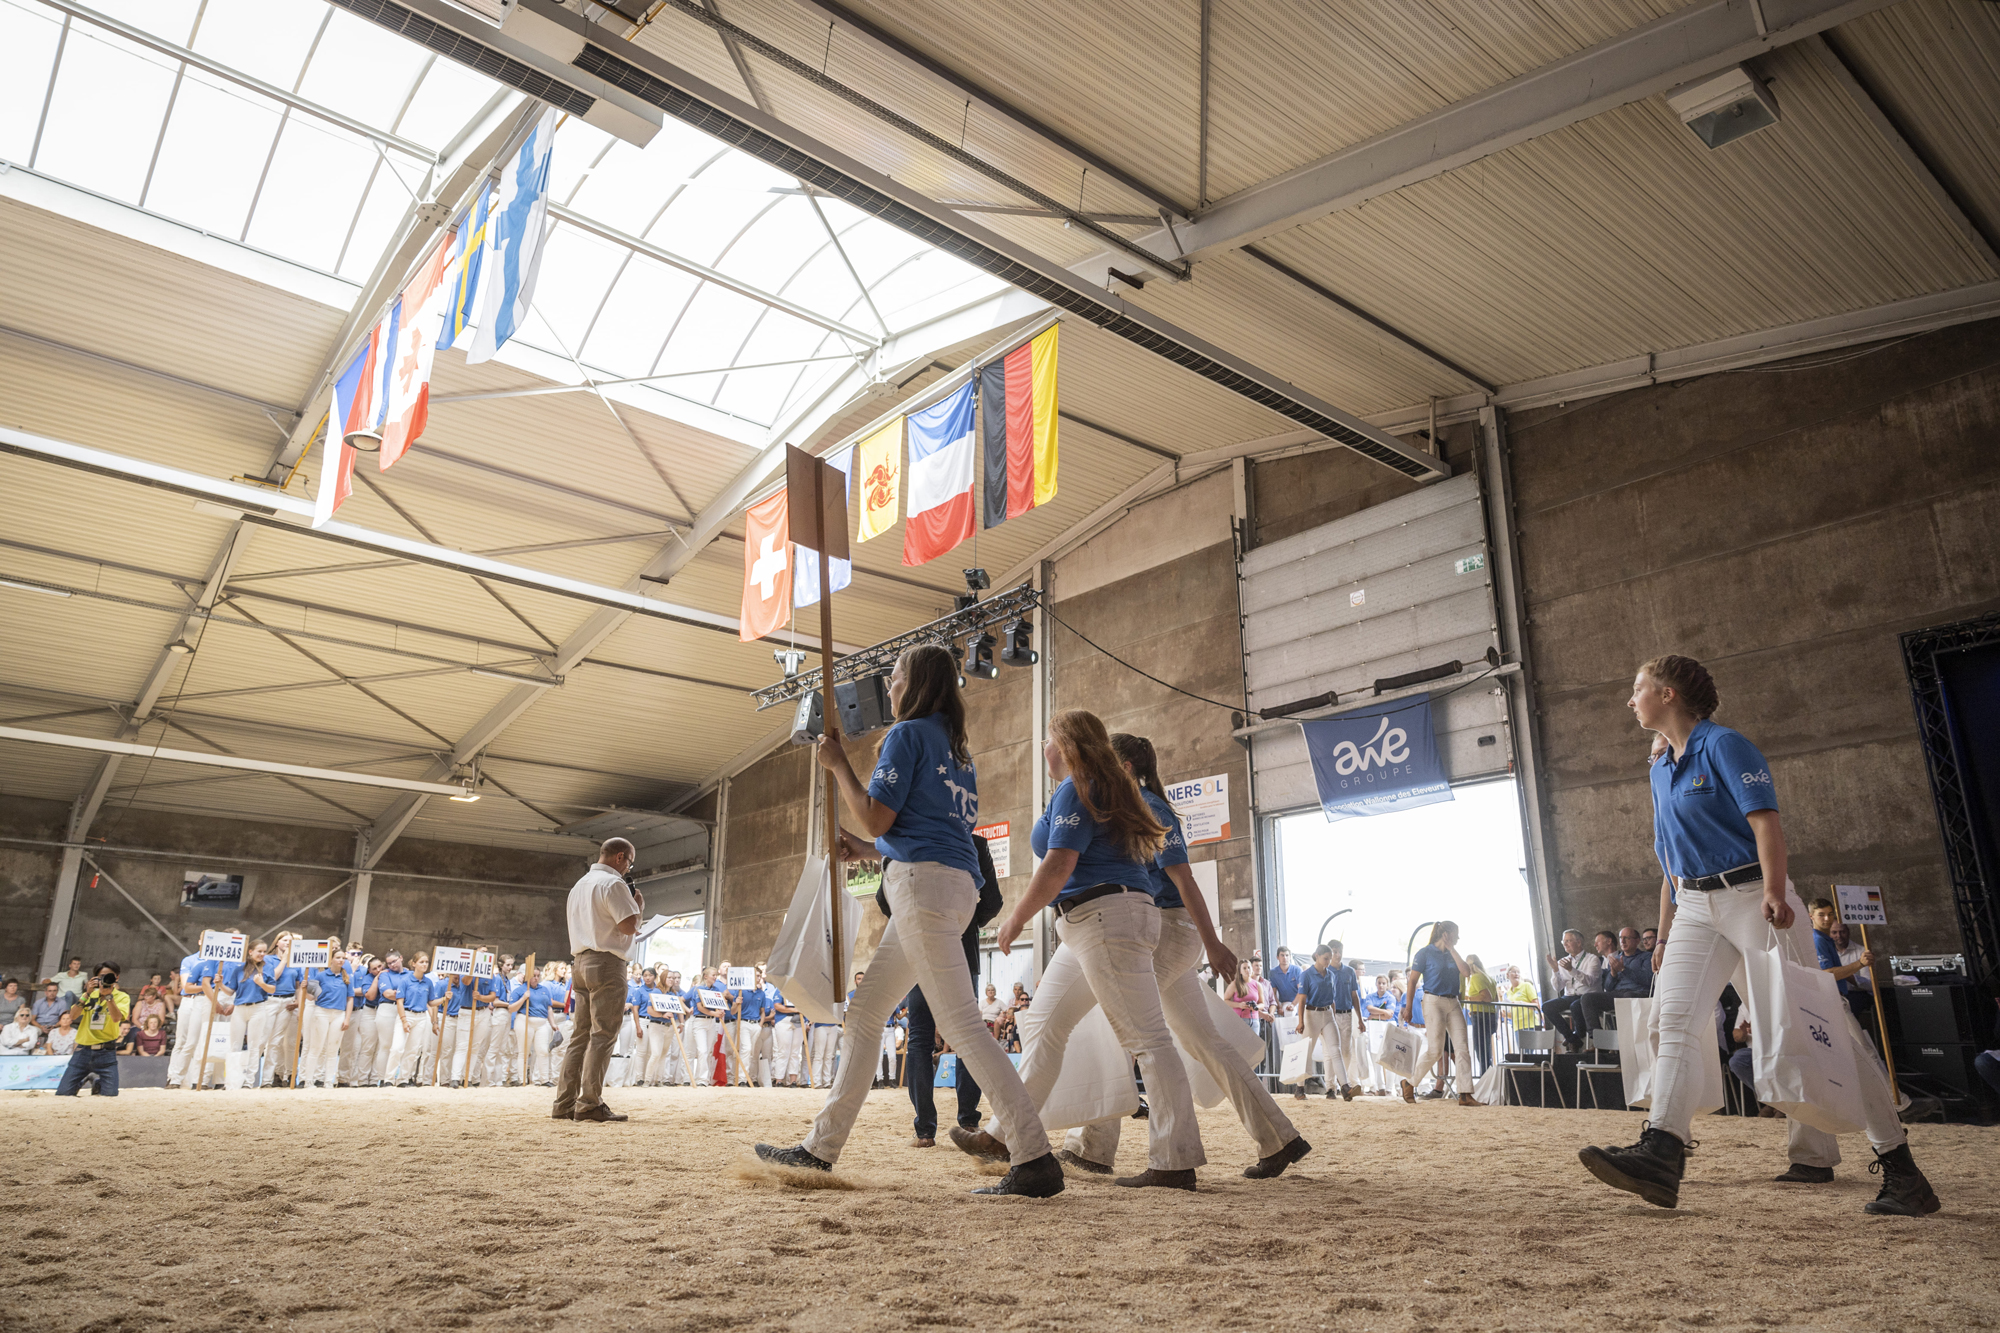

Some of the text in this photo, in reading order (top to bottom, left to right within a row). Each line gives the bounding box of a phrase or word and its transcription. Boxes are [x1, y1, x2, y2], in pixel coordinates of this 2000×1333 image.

[1332, 717, 1410, 775] awe
[1340, 764, 1412, 788] GROUPE
[1168, 779, 1223, 801] NERSOL
[1363, 794, 1397, 805] Wallonne
[1398, 790, 1411, 798] des
[1412, 783, 1445, 796] Eleveurs
[1844, 913, 1875, 921] GROUP
[204, 944, 242, 959] PAYS-BAS
[292, 952, 328, 964] MASTERRIND
[436, 959, 471, 973] LETTONIE
[474, 962, 492, 975] ALIE
[655, 1001, 682, 1012] FINLANDE
